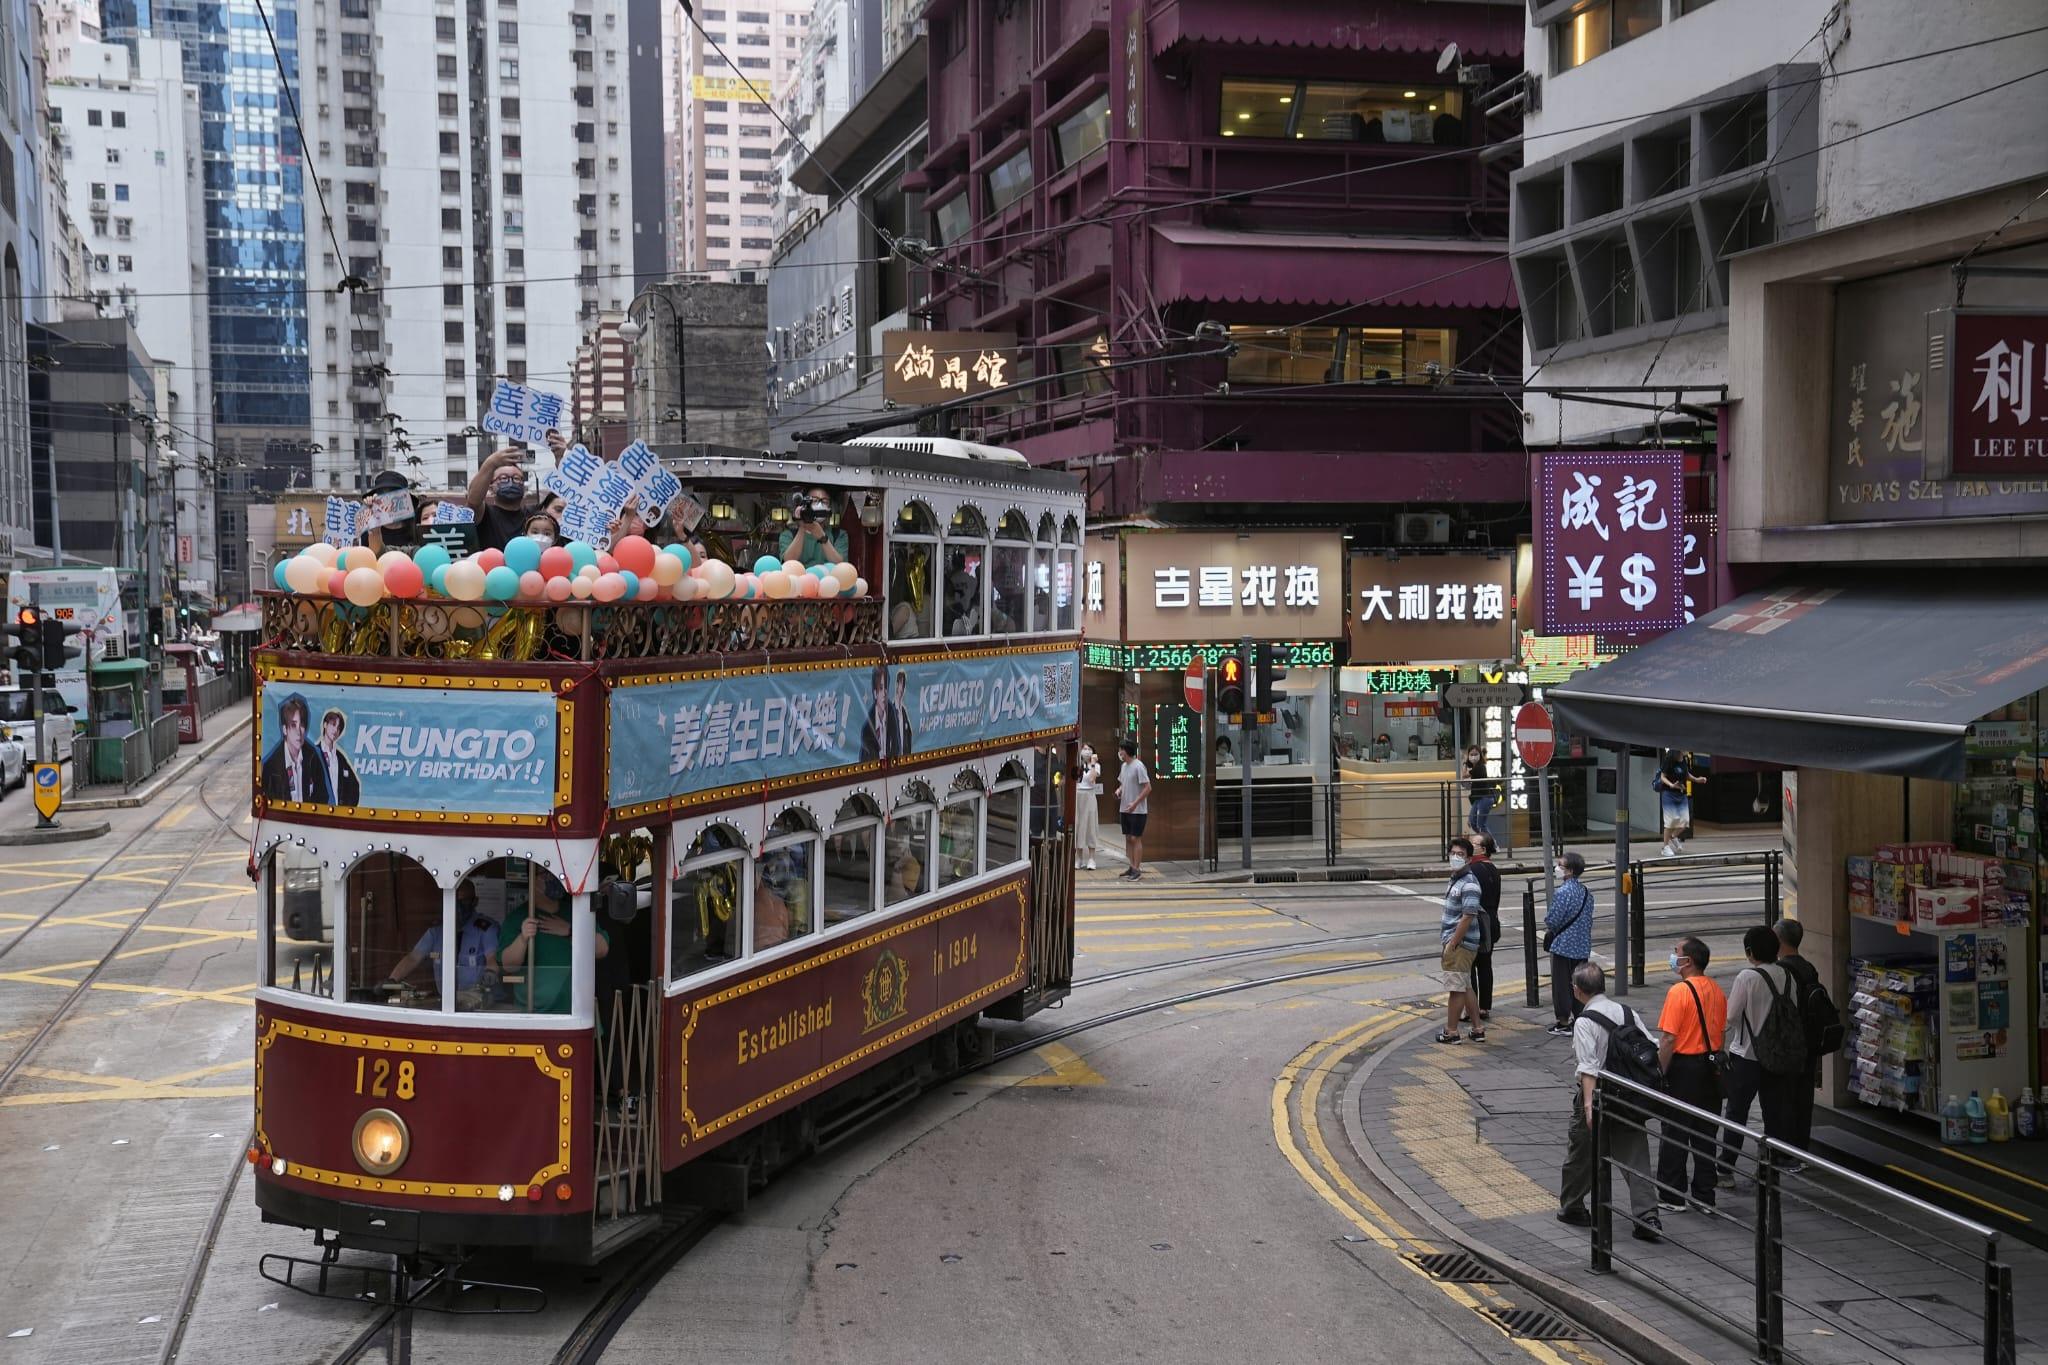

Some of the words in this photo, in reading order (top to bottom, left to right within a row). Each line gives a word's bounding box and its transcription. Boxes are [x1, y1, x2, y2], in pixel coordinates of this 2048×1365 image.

[1972, 339, 2048, 426] 利
[485, 415, 523, 439] Keung
[493, 382, 563, 428] 姜濤
[1973, 438, 2016, 457] LEE
[562, 446, 633, 511] 姜濤
[621, 441, 680, 508] 姜濤
[1839, 480, 1900, 504] YURA'S
[1908, 480, 1943, 500] SZE
[1561, 471, 1668, 541] 成記
[561, 525, 585, 541] eung
[56, 608, 74, 619] 905
[919, 679, 985, 713] KEUNGTO
[988, 674, 1040, 723] 0430
[354, 724, 536, 761] KEUNGTO
[918, 713, 944, 733] HAPPY
[353, 758, 416, 777] HAPPY
[932, 949, 944, 977] in
[949, 933, 978, 969] 1904
[737, 996, 834, 1066] Established
[354, 1056, 415, 1100] 128
